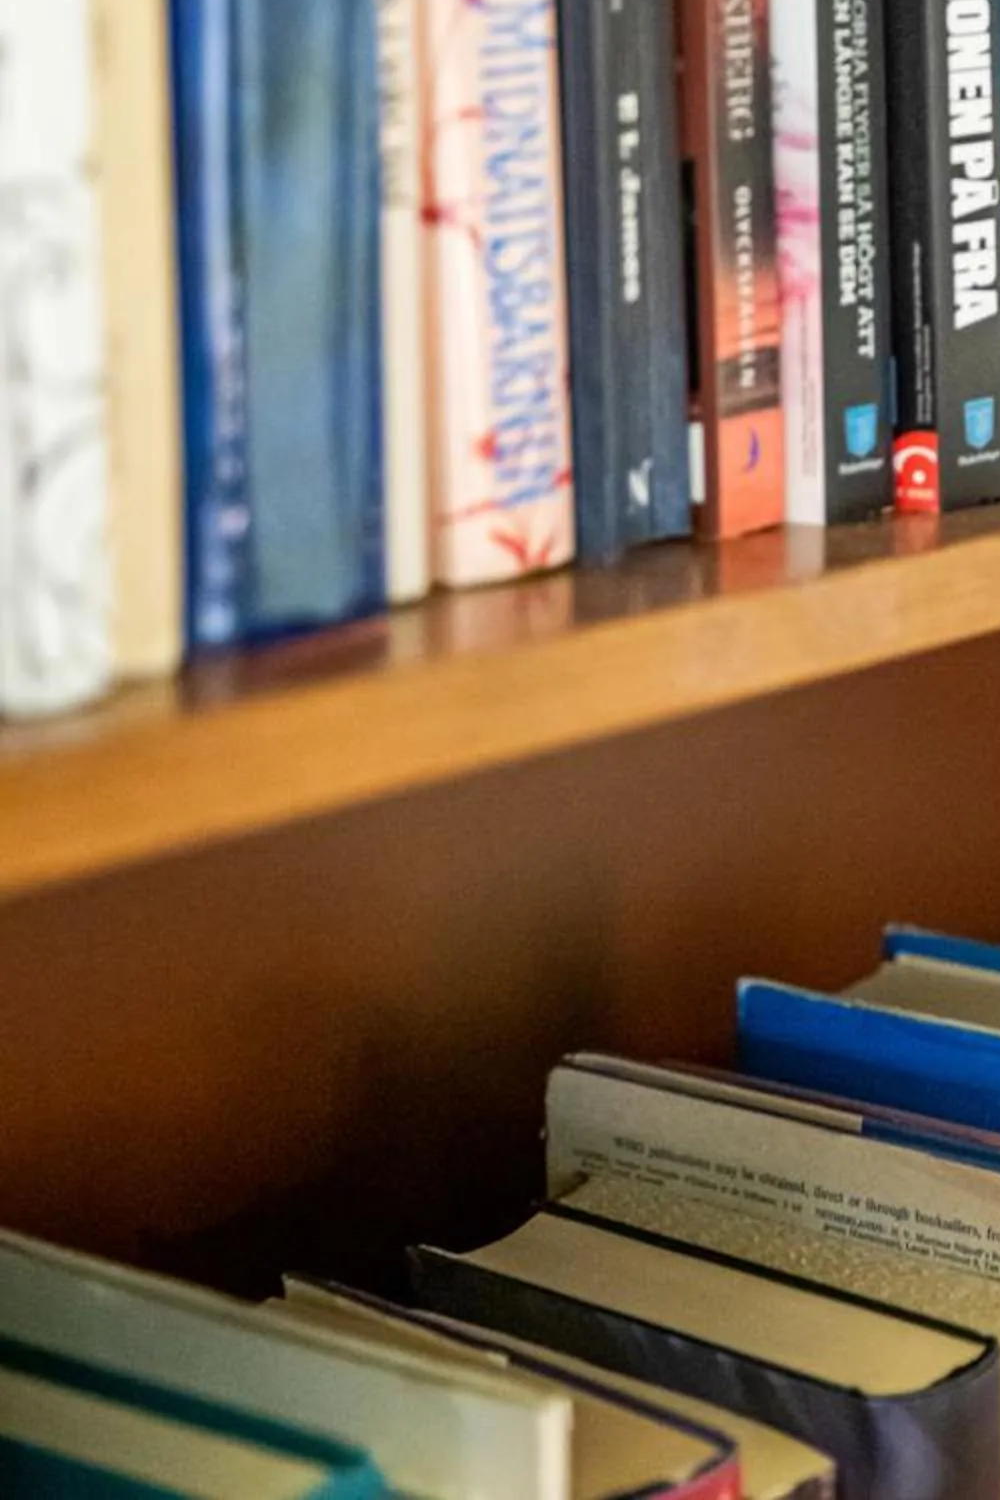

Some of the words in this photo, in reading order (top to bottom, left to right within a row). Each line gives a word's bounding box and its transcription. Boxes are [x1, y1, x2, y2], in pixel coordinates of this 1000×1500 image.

[836, 141, 855, 203] KAN
[851, 82, 871, 183] FLYGER
[950, 139, 1000, 218] PÅ
[621, 167, 643, 303] James
[837, 207, 856, 240] SE
[855, 220, 877, 300] HÖGT
[839, 243, 859, 307] DEM
[952, 218, 1000, 330] FRA
[857, 304, 877, 360] ATT
[648, 1147, 711, 1174] publications
[714, 1161, 739, 1181] may
[741, 1164, 755, 1181] be
[758, 1172, 809, 1200] obtained,
[813, 1185, 844, 1208] direct
[847, 1192, 862, 1208] or
[865, 1194, 911, 1223] through
[914, 1208, 983, 1241] booksellers,
